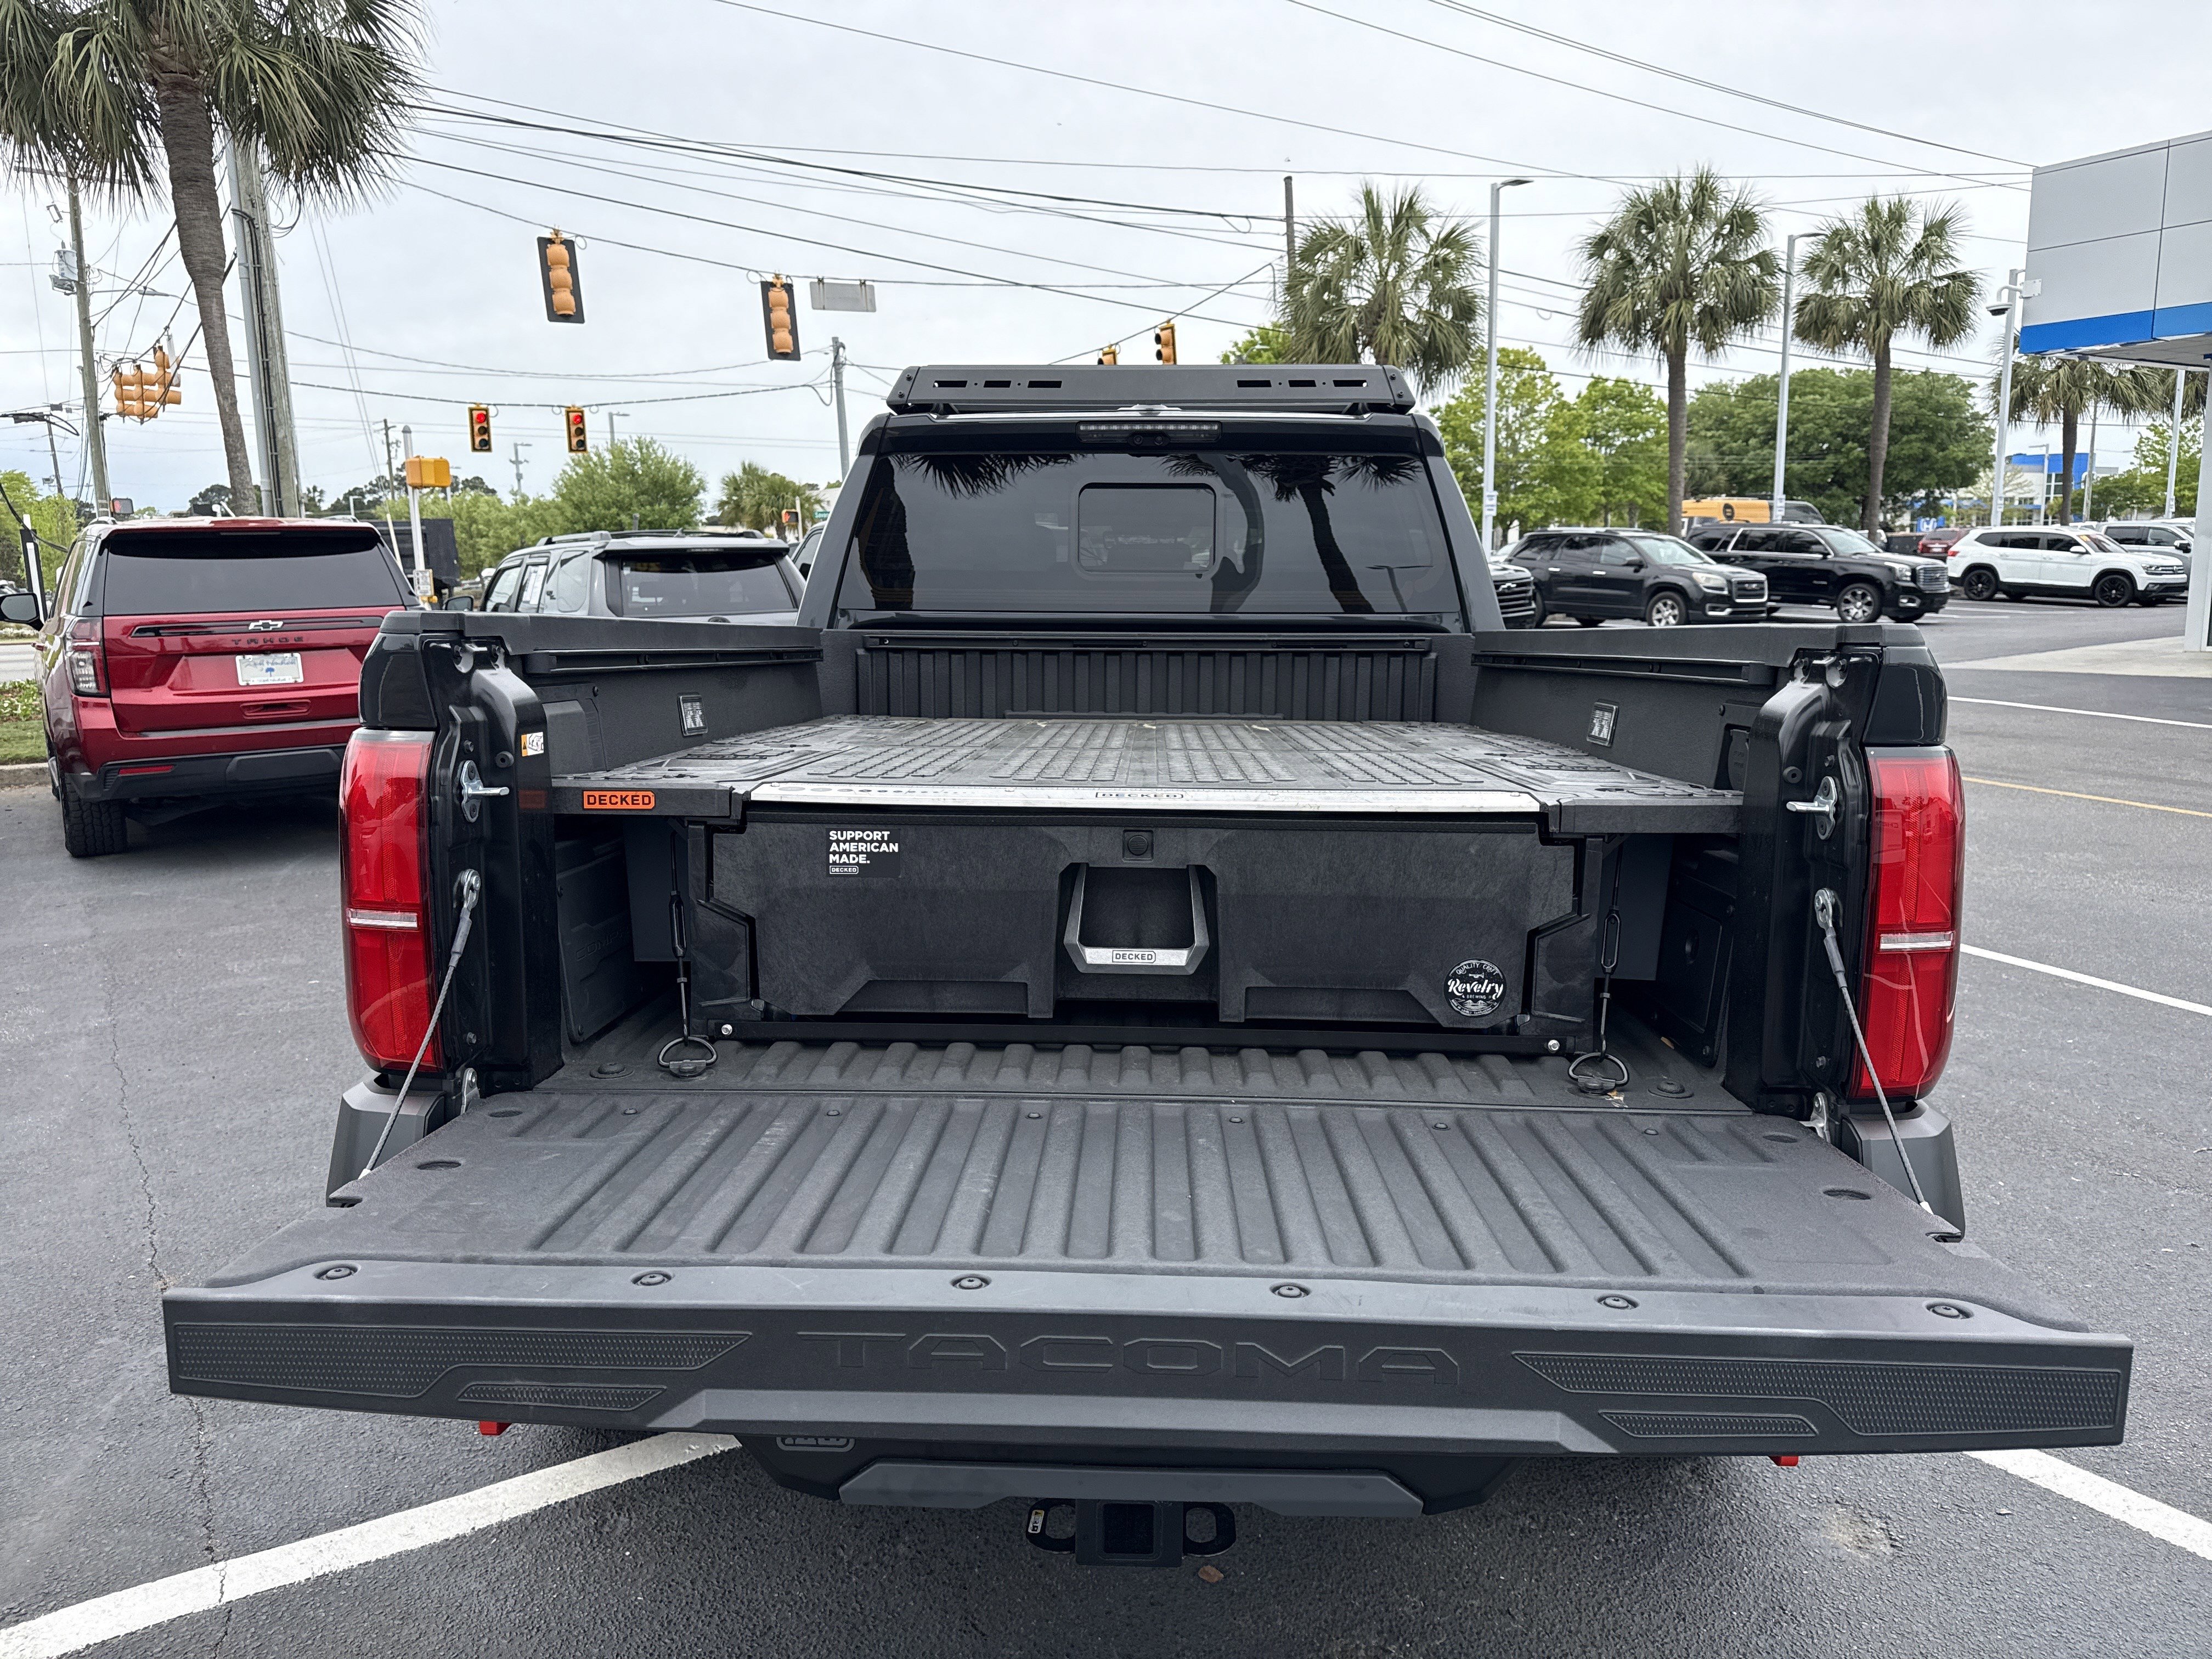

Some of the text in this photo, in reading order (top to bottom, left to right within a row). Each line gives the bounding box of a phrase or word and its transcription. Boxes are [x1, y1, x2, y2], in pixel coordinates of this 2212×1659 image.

[232, 636, 303, 645] TAHOE
[587, 794, 651, 805] DECKED
[829, 831, 890, 840] SUPPORT
[829, 842, 898, 852] AMERICAN
[829, 854, 870, 864] MADE.
[1455, 963, 1480, 974] QUALITY
[1448, 979, 1503, 1000] Revelry
[797, 1331, 1459, 1385] TACOMA
